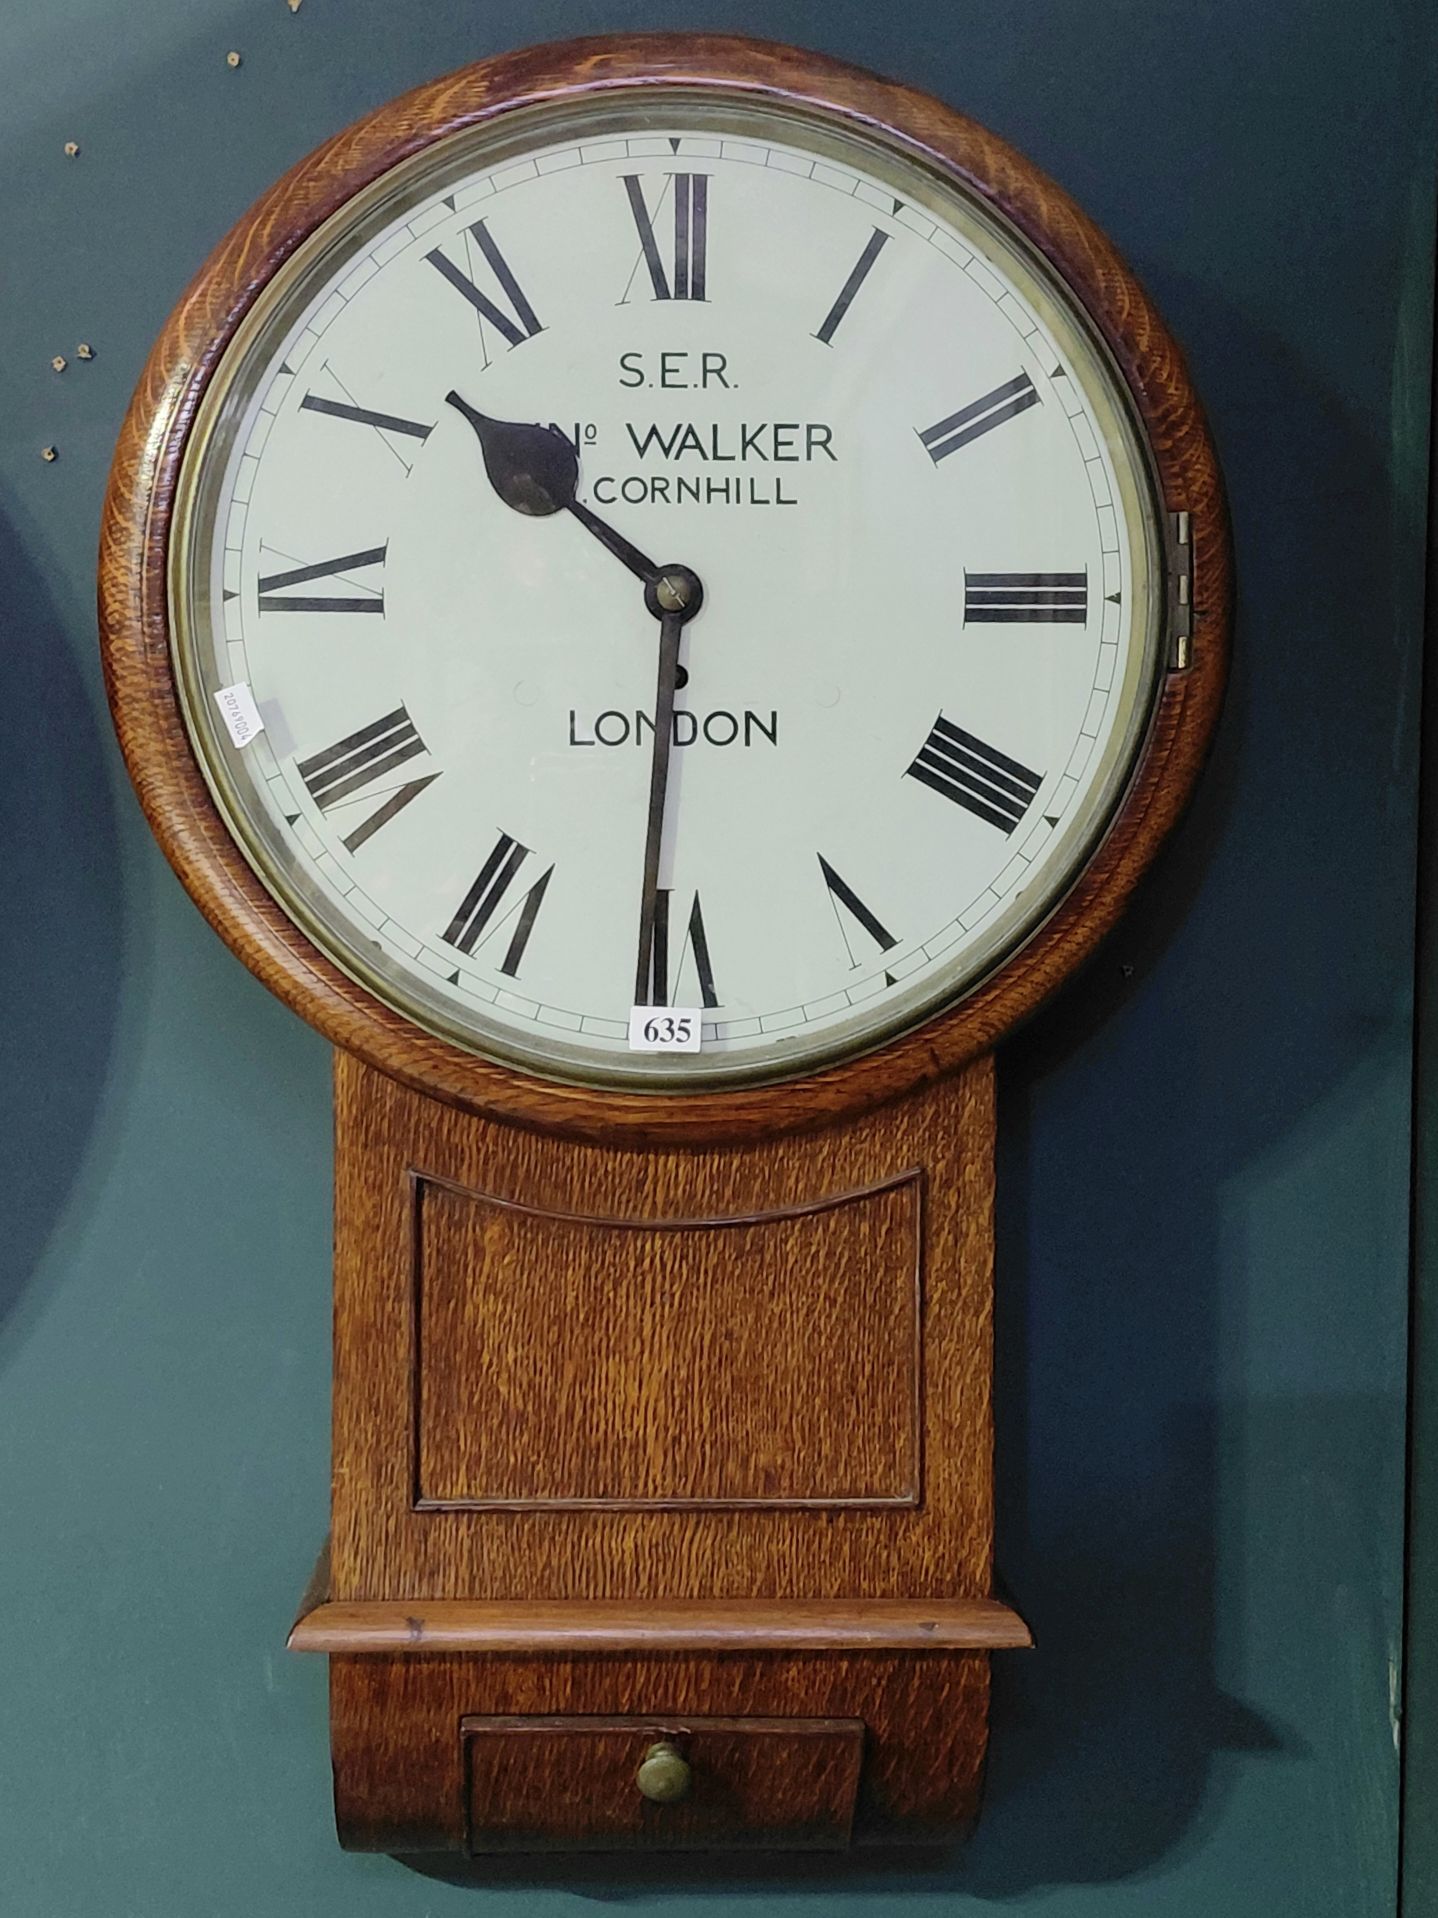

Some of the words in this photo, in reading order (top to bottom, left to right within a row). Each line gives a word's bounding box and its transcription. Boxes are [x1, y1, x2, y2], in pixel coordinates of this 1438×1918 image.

[420, 217, 550, 371] XI
[614, 172, 713, 305] XII
[810, 226, 894, 347] I
[299, 360, 438, 476] X
[619, 353, 739, 389] S.E.R.
[913, 365, 1043, 468] II
[626, 423, 839, 461] WALKER
[257, 537, 389, 618] IX
[962, 564, 1088, 629] III
[293, 700, 443, 855] VIII
[569, 710, 778, 747] LONDON
[902, 709, 1046, 839] IIII
[437, 829, 556, 978] VII
[816, 852, 902, 970] V
[644, 1016, 692, 1043] 635
